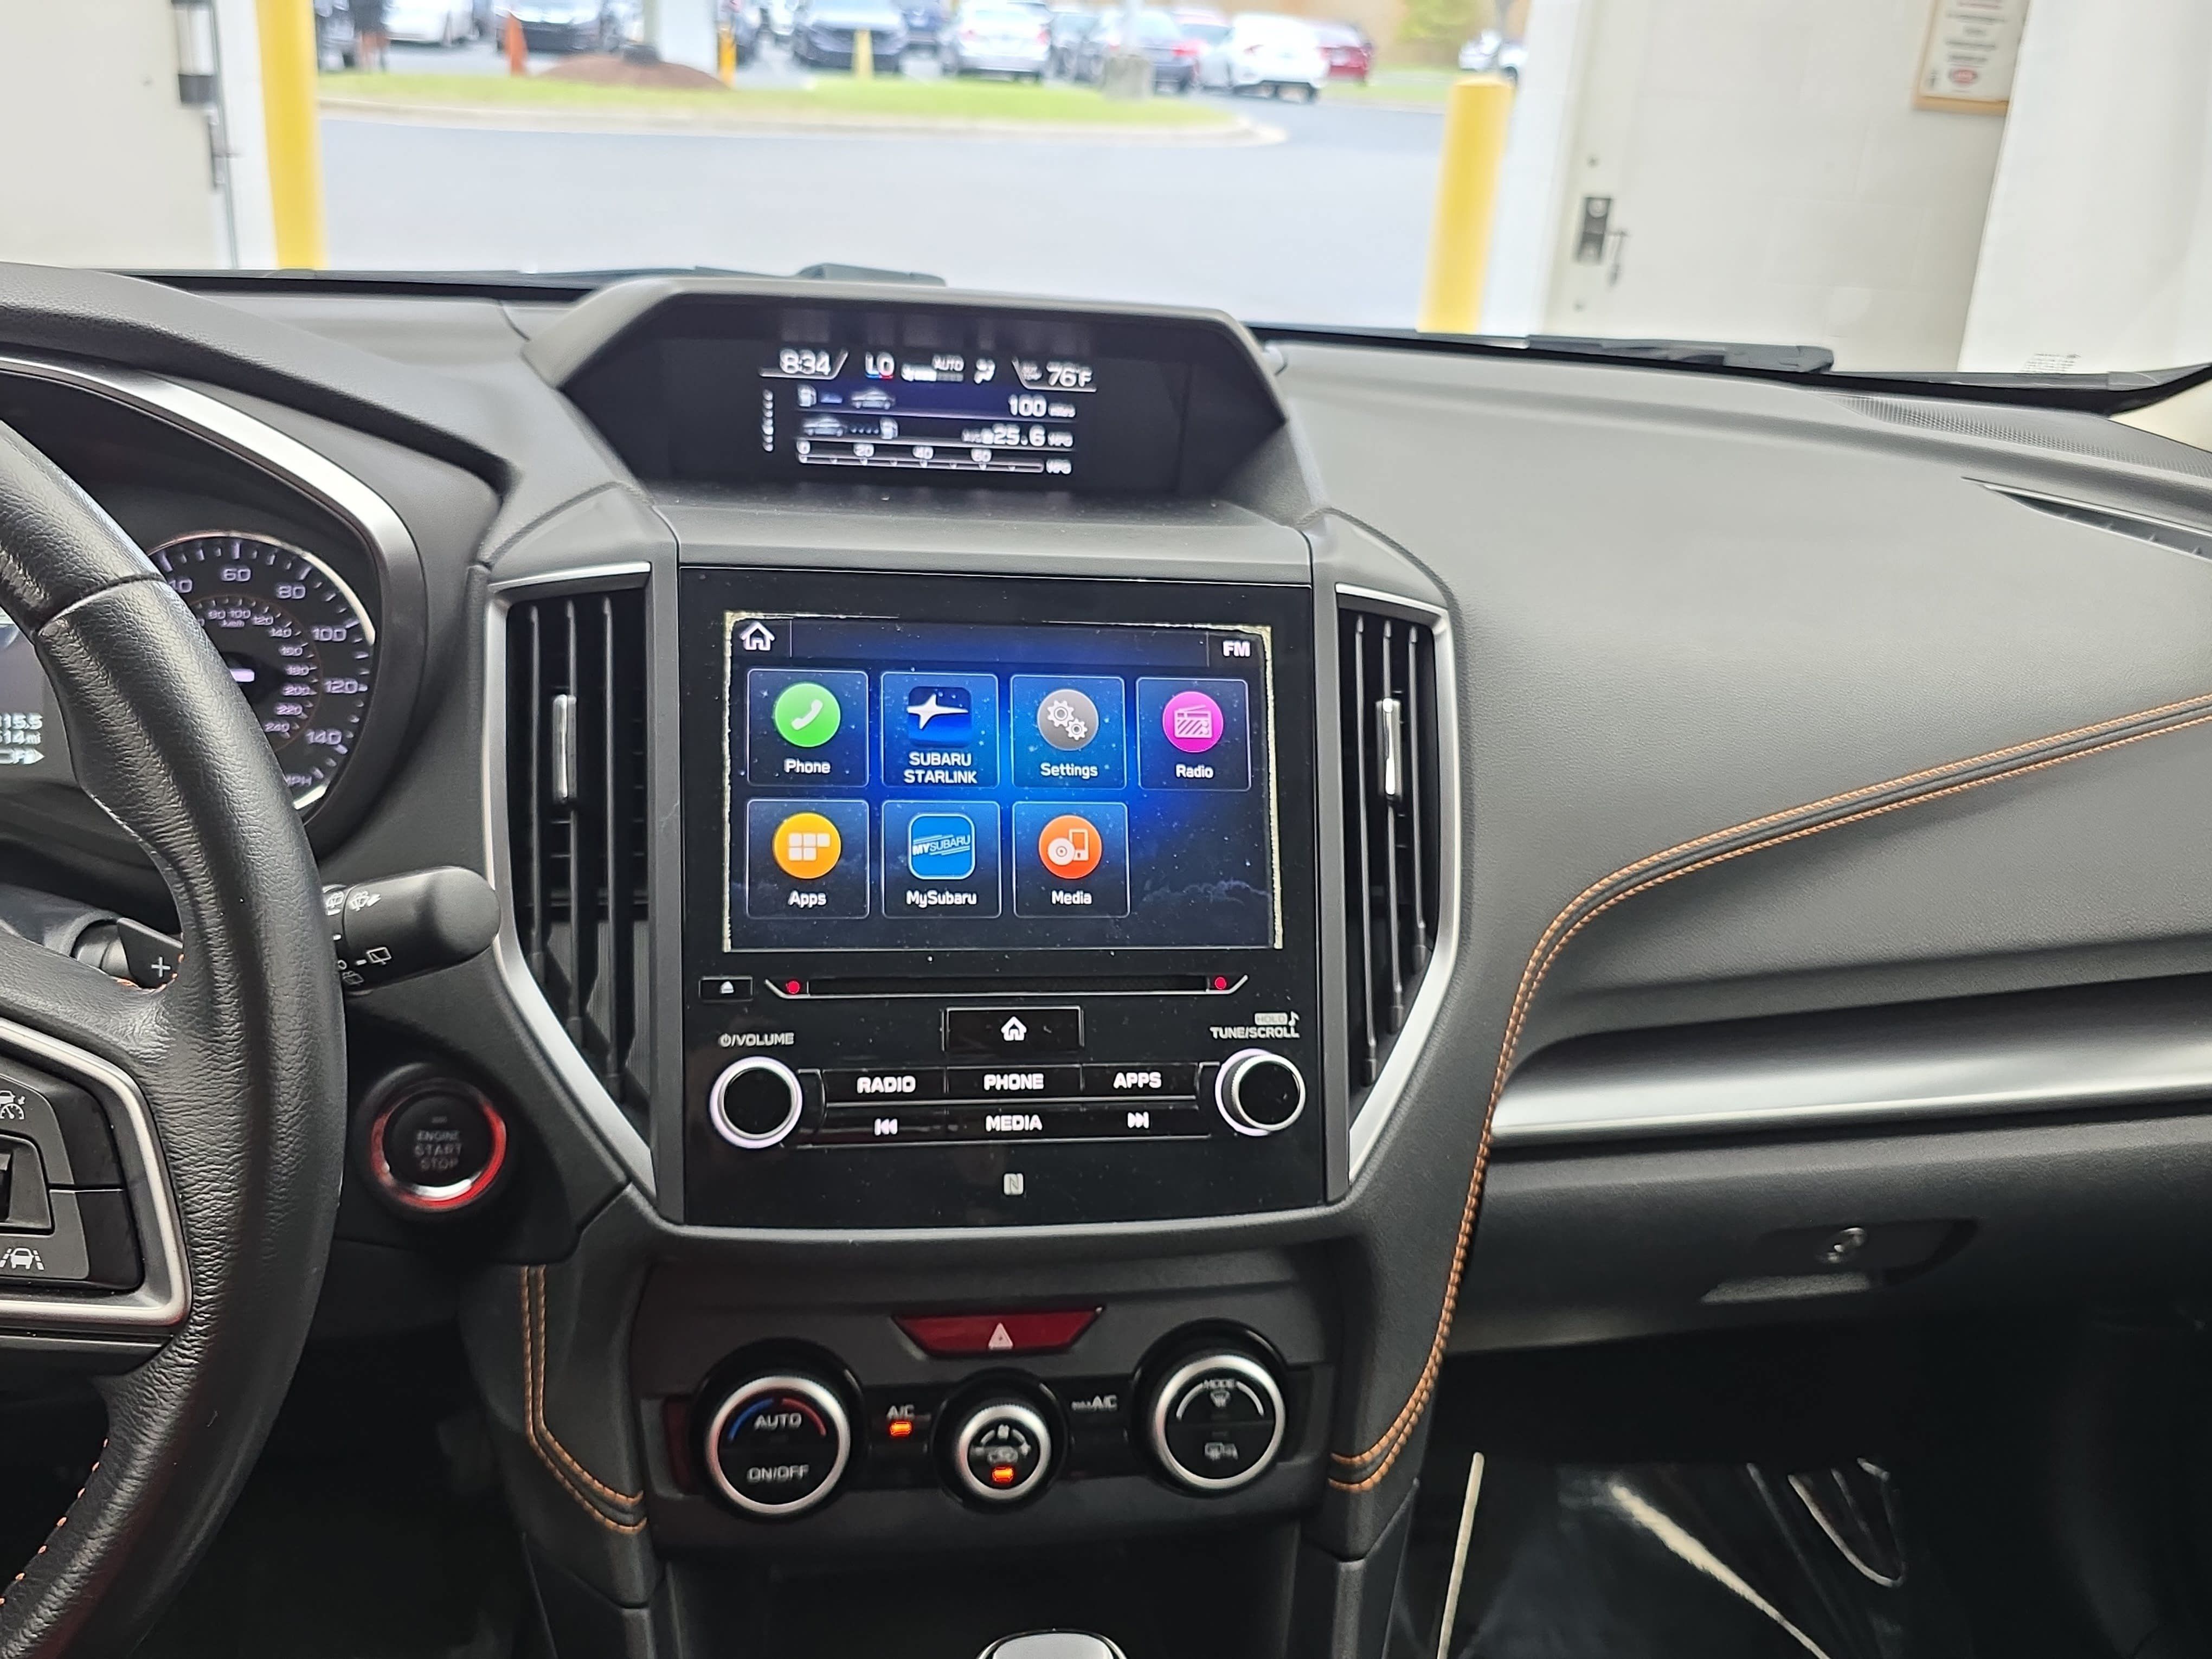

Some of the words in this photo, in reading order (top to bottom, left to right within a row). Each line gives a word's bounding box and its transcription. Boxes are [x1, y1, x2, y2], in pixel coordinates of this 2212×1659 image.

[865, 351, 895, 375] LO
[931, 354, 964, 371] AUTO
[1008, 394, 1047, 417] 100
[221, 568, 252, 582] 60
[277, 584, 306, 599] 80
[311, 627, 347, 642] 100
[1223, 640, 1250, 657] FM
[324, 679, 358, 694] 120
[305, 729, 343, 745] 140
[784, 757, 831, 775] Phone
[909, 751, 972, 767] SUBARU
[904, 769, 978, 785] STARLINK
[1040, 762, 1098, 780] Settings
[1176, 764, 1214, 780] Radio
[788, 890, 827, 908] Apps
[906, 890, 977, 908] MySubaru
[1051, 890, 1092, 905] Media
[1210, 1026, 1300, 1039] TUNE/SCROLL
[857, 1075, 916, 1094] RADIO
[983, 1072, 1045, 1091] PHONE
[1113, 1071, 1162, 1089] APPS
[986, 1114, 1043, 1133] MEDIA
[754, 1413, 802, 1429] AUTO
[747, 1464, 809, 1482] ON/OFF
